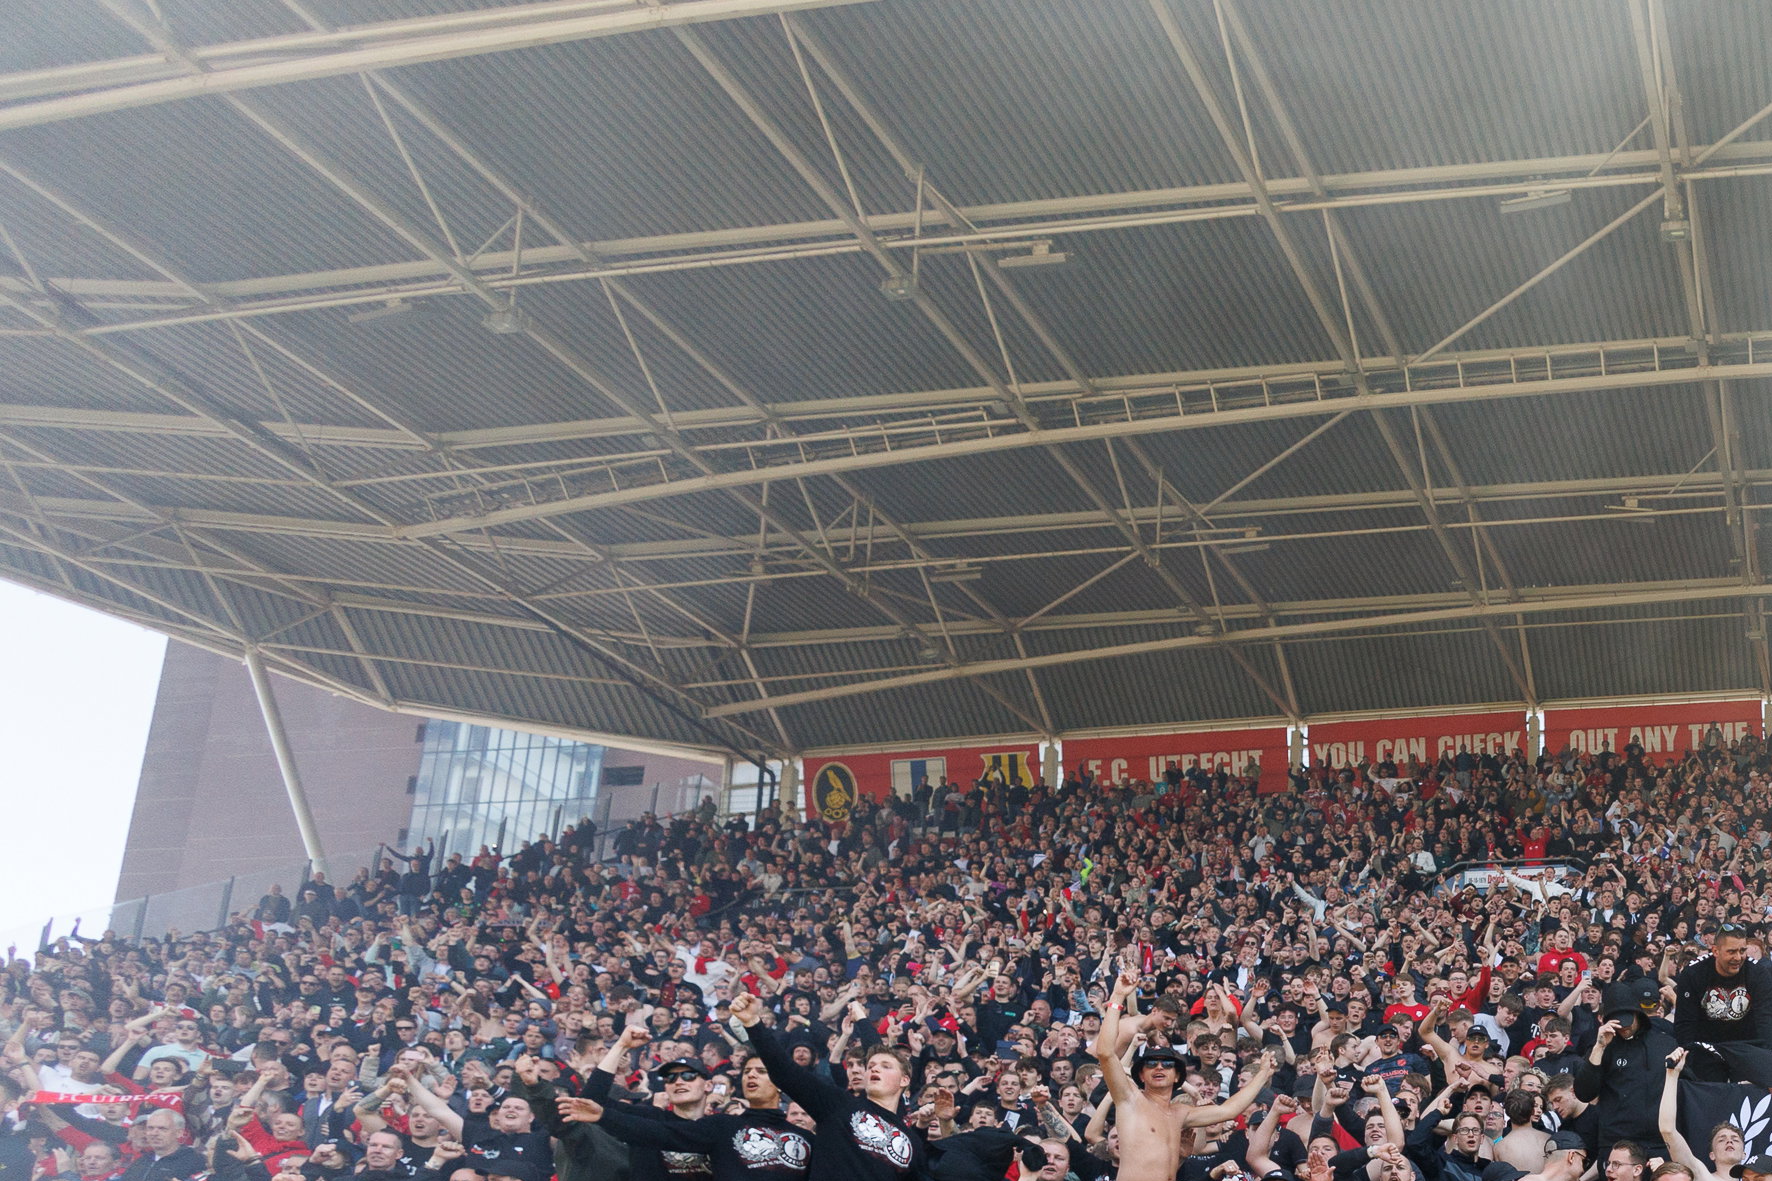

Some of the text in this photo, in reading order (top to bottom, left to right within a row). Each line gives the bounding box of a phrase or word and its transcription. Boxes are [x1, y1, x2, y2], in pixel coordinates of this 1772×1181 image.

[1313, 731, 1522, 769] YOU CAN CHECK
[1569, 727, 1619, 755] OUT
[1629, 725, 1679, 753] ANY
[58, 1093, 181, 1104] FC UTRECHT
